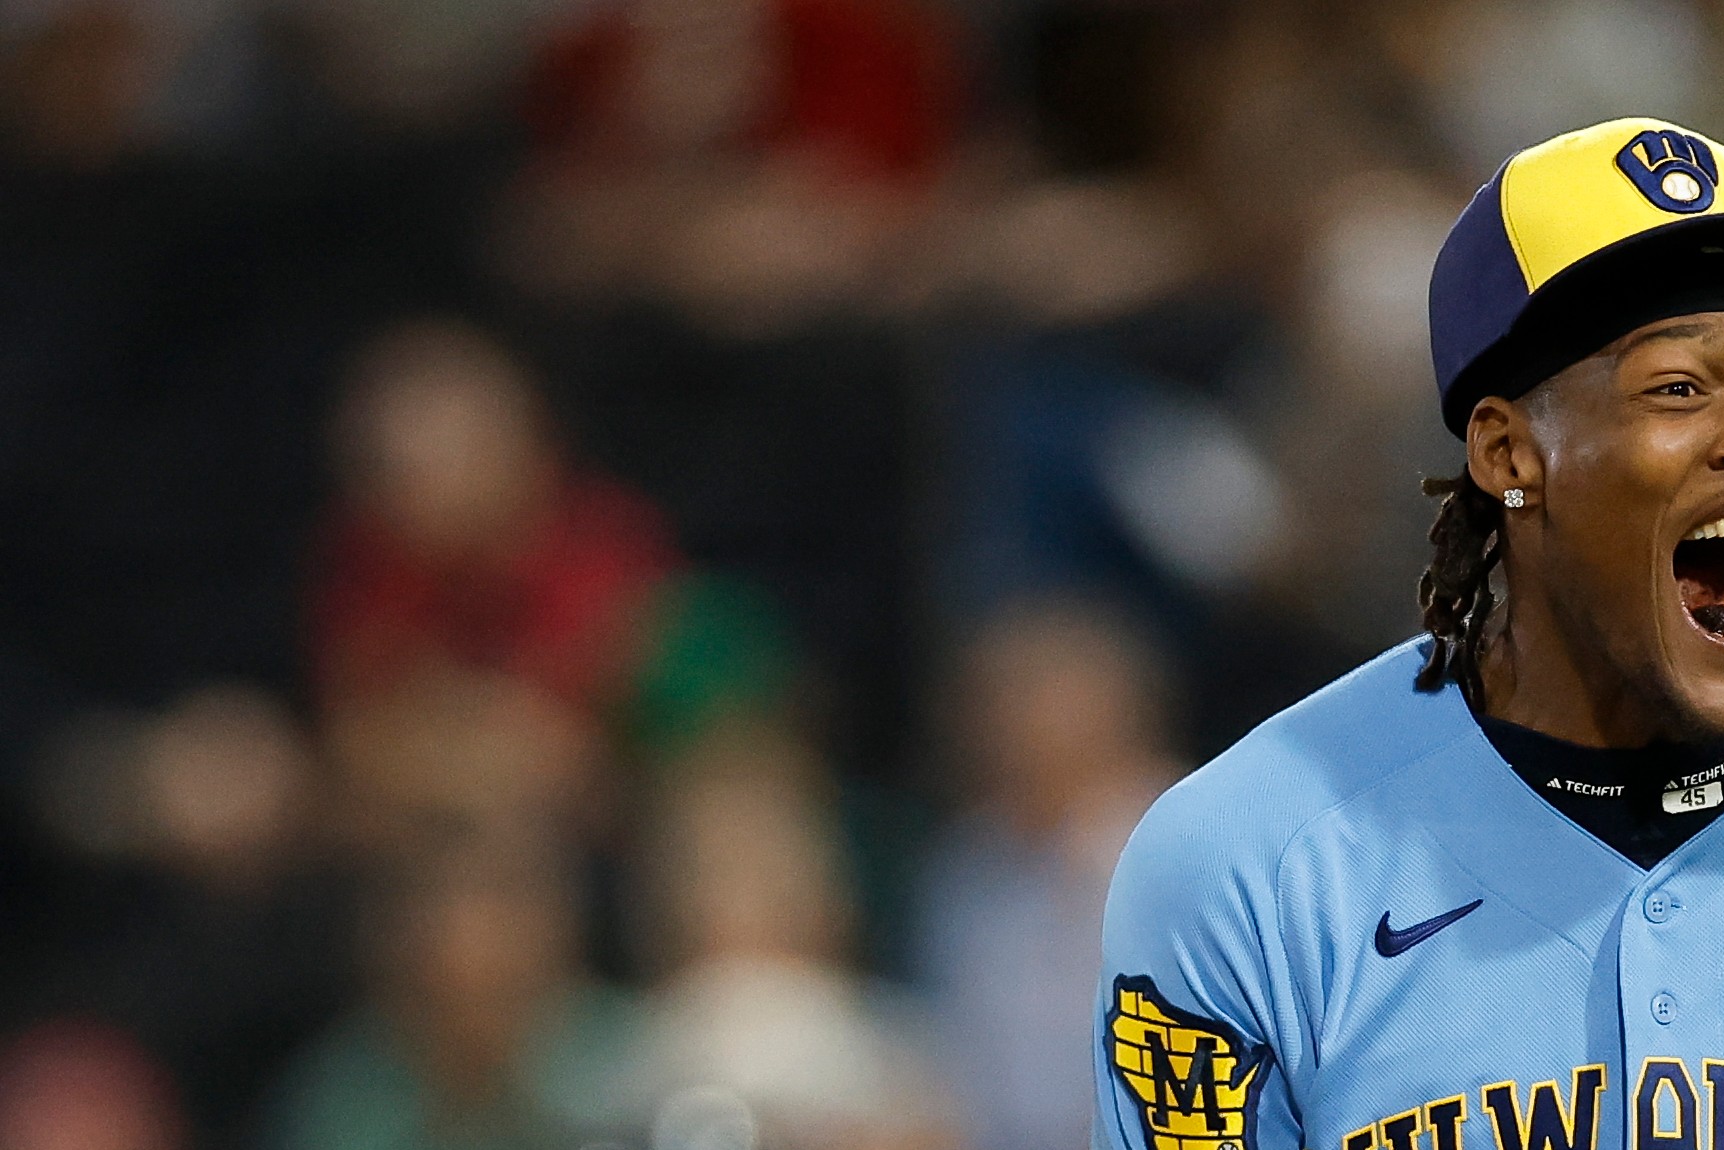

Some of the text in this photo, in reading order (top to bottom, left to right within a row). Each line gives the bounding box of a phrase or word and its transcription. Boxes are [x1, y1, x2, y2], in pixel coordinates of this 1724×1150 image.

[1565, 779, 1625, 797] TECHFIT
[1680, 787, 1706, 807] 45
[1144, 1029, 1227, 1132] M
